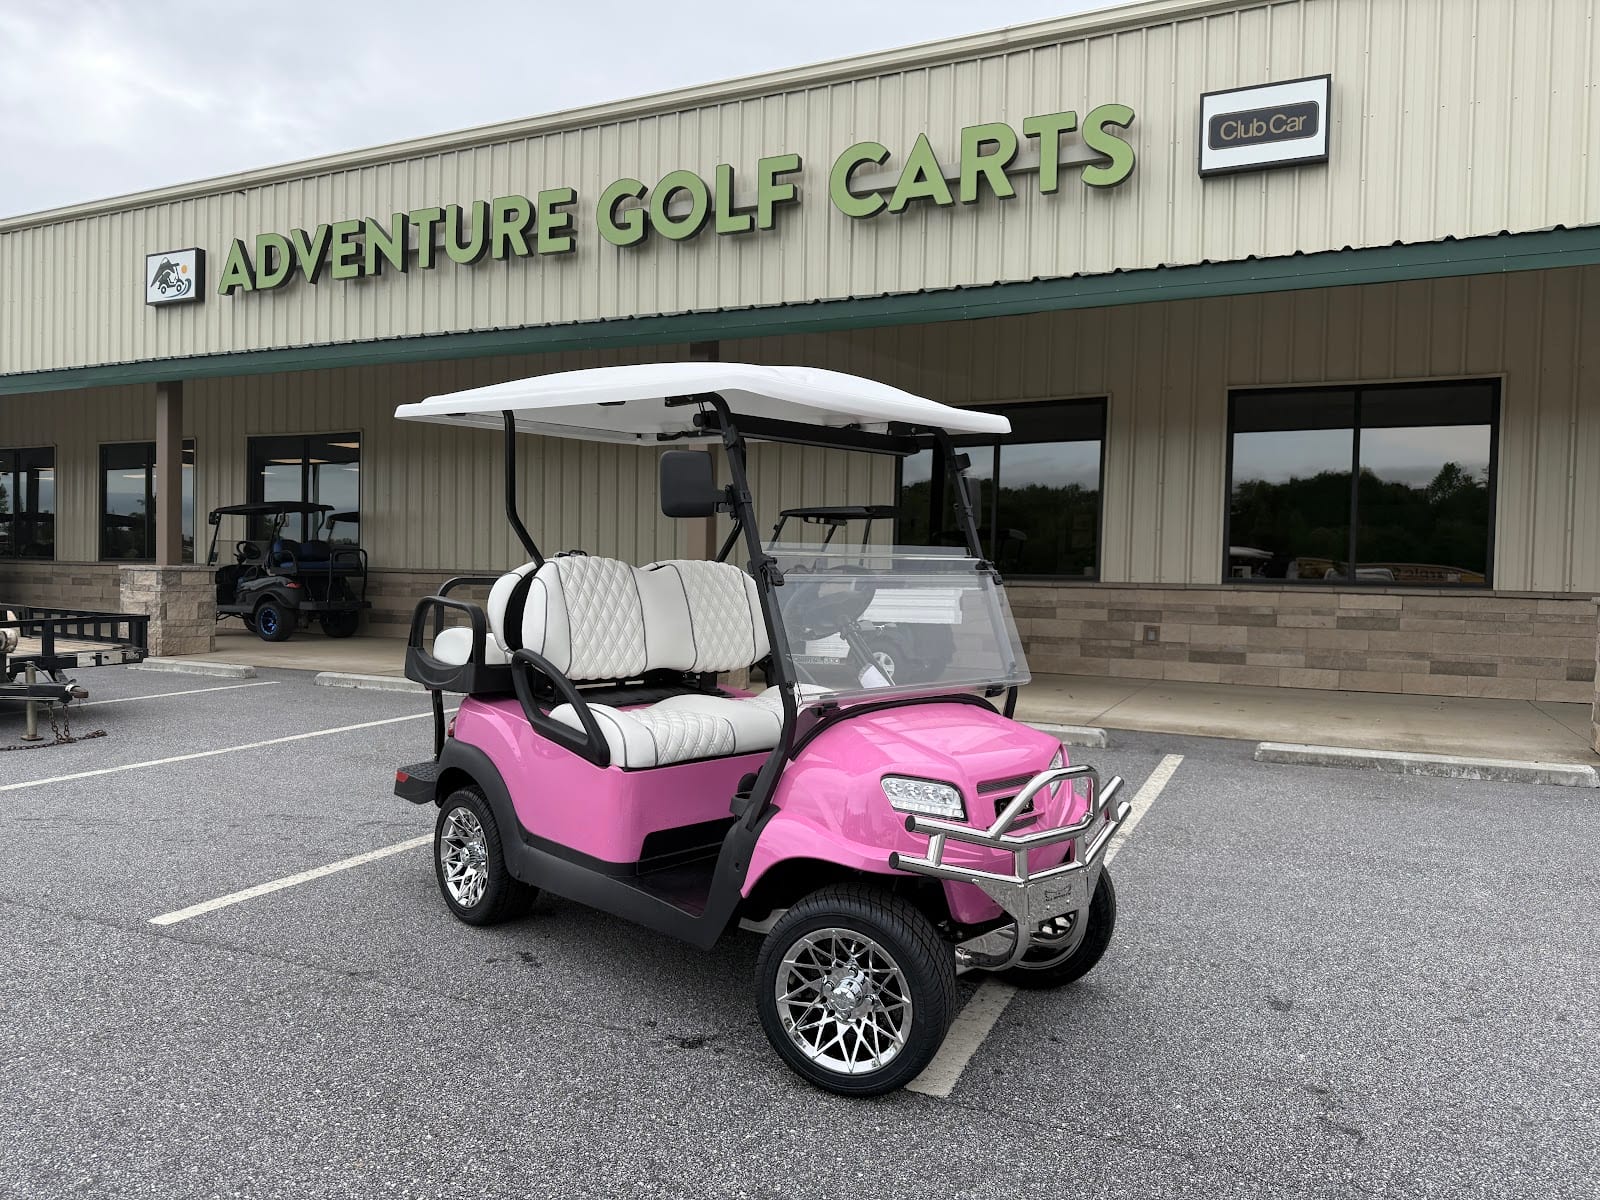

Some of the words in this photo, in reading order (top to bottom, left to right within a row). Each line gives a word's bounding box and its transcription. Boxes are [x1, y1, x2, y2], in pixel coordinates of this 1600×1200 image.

[1220, 118, 1266, 140] Club
[1269, 114, 1307, 134] Car
[217, 187, 576, 296] ADVENTURE
[596, 153, 801, 247] GOLF
[829, 103, 1136, 218] CARTS
